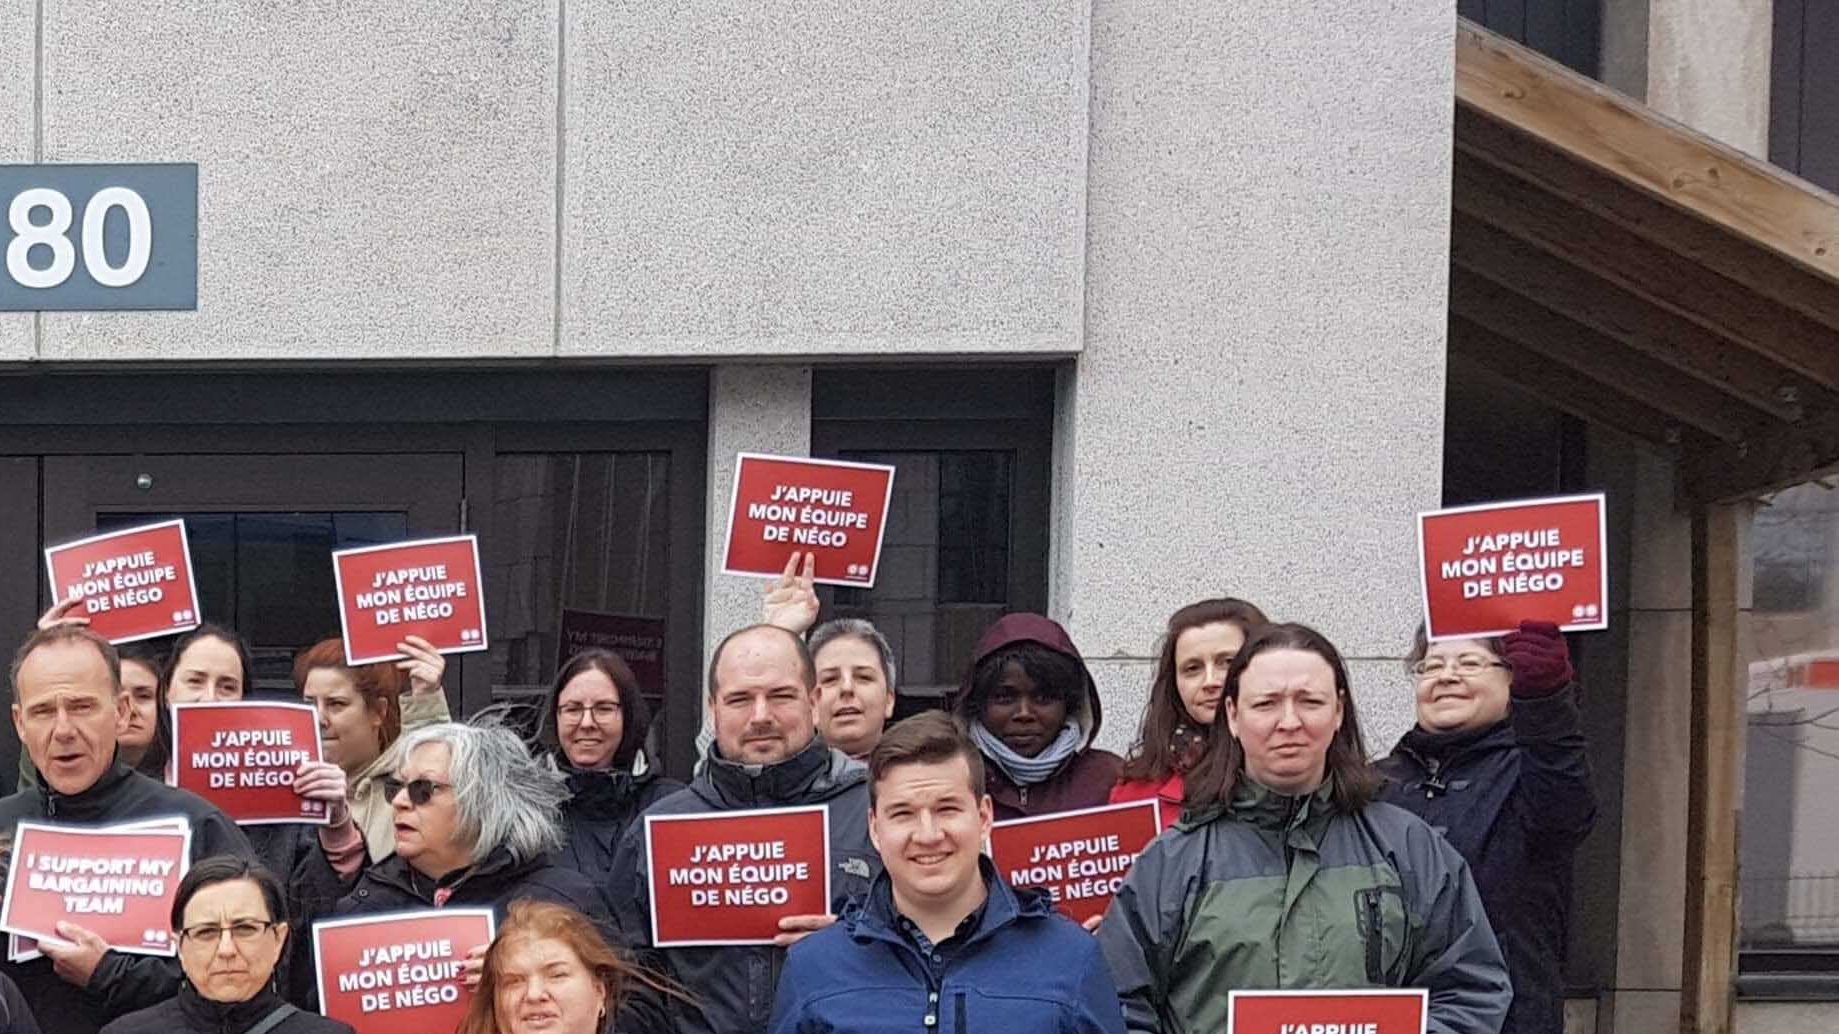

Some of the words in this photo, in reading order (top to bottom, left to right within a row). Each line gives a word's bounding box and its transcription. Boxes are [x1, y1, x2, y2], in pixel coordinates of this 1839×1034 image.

[770, 485, 853, 507] J'APPUIE
[748, 503, 797, 523] MON
[800, 506, 868, 529] ÉQUIPE
[763, 525, 789, 541] DE
[793, 527, 847, 547] NÉGO
[1463, 528, 1560, 555] J'APPUIE
[82, 551, 155, 578] J'APPUIE
[1441, 557, 1497, 579] MON
[1502, 549, 1584, 573] ÉQUIPE
[68, 578, 111, 599] MON
[113, 566, 176, 589] ÉQUIPE
[372, 564, 447, 588] J'APPUIE
[1463, 580, 1493, 599] DE
[1498, 573, 1563, 595] NÉGO
[86, 598, 111, 613] DE
[113, 587, 163, 609] NÉGO
[356, 589, 401, 609] MON
[405, 582, 467, 601] ÉQUIPE
[375, 608, 400, 625] DE
[403, 602, 454, 622] NÉGO
[211, 730, 292, 748] J'APPUIE
[192, 751, 240, 769] MON
[209, 772, 235, 788] DE
[240, 769, 295, 787] NÉGO
[690, 841, 786, 863] J'APPUIE
[1030, 834, 1120, 863] J'APPUIE
[26, 853, 35, 868] I
[38, 855, 137, 874] SUPPORT
[139, 859, 175, 876] MY
[669, 868, 723, 885] MON
[728, 862, 809, 884] ÉQUIPE
[1011, 865, 1063, 886] MON
[29, 872, 164, 896] BARGAINING
[691, 890, 720, 906] DE
[725, 885, 788, 905] NÉGO
[1049, 885, 1061, 902] E
[64, 896, 125, 914] TEAM
[359, 939, 453, 967] J'APPUIE
[338, 970, 393, 993] MON
[361, 994, 391, 1013] DE
[395, 984, 459, 1008] NÉGO
